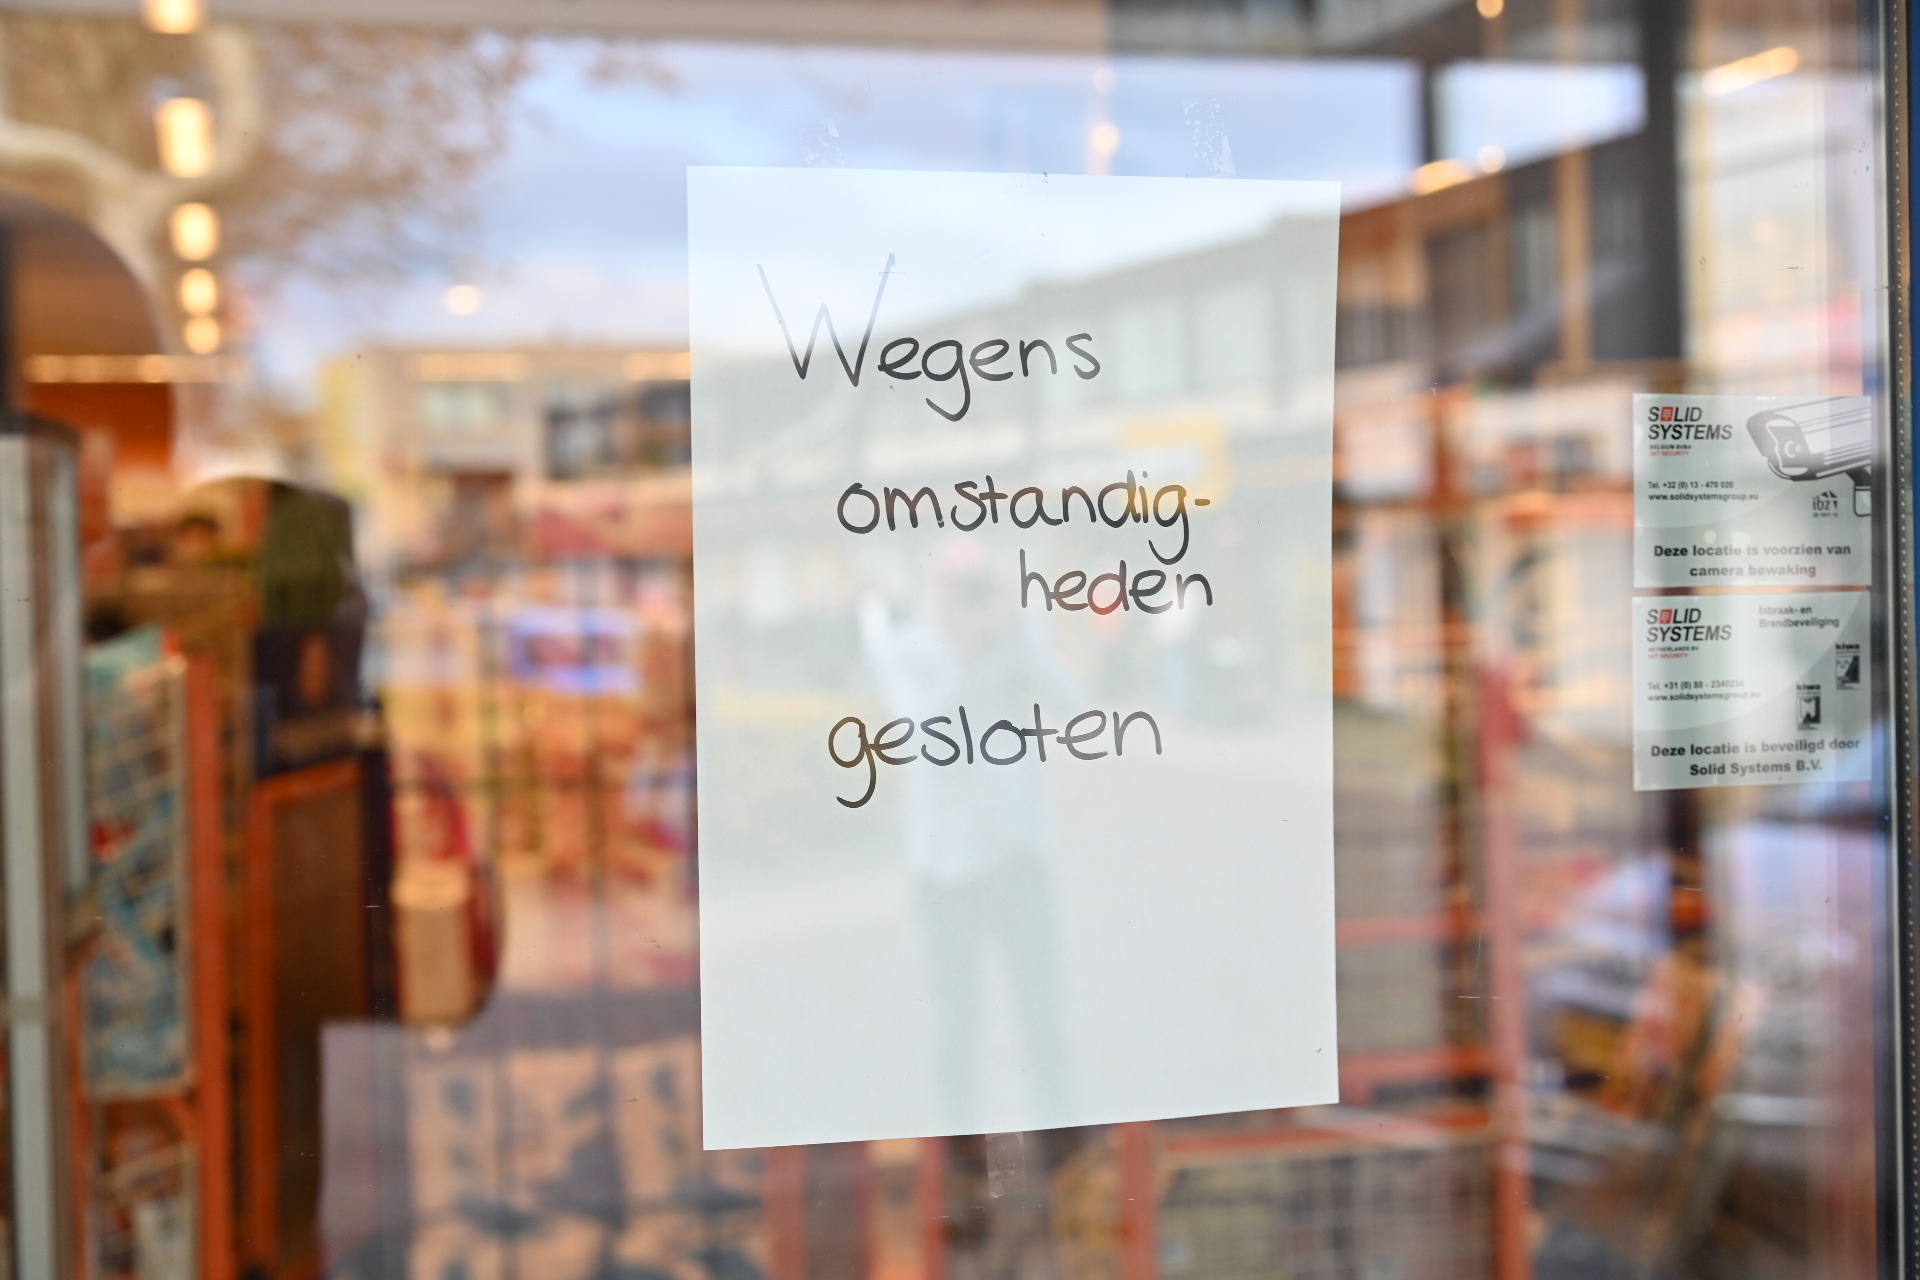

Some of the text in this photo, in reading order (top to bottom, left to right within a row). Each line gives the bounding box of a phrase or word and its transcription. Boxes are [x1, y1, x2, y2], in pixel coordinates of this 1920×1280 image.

[755, 251, 1101, 422] Wegens
[1647, 424, 1733, 440] SYSTEMS
[1648, 481, 1661, 489] Tel.
[1662, 481, 1677, 489] +32
[1678, 481, 1688, 490] (0)
[1690, 481, 1699, 489] 13
[1705, 481, 1719, 489] 470
[1648, 493, 1759, 502] www.solidsystemsgroup.eu
[836, 469, 1212, 566] omstandig-
[1654, 543, 1851, 557] Deze locatie is voorzien van
[1690, 563, 1816, 577] camera bewaking
[1018, 548, 1214, 616] heden
[1759, 606, 1798, 616] Inbraak-
[1759, 618, 1840, 628] Brandbeveiliging
[1646, 625, 1732, 642] SYSTEMS
[1680, 681, 1691, 690] (0)
[1648, 692, 1760, 702] www.solidsystemsgroup.eu
[827, 702, 1163, 809] gesloten
[1651, 739, 1861, 757] Deze locatie is beveiligd door
[1690, 760, 1823, 777] Solid Systems B.V.
